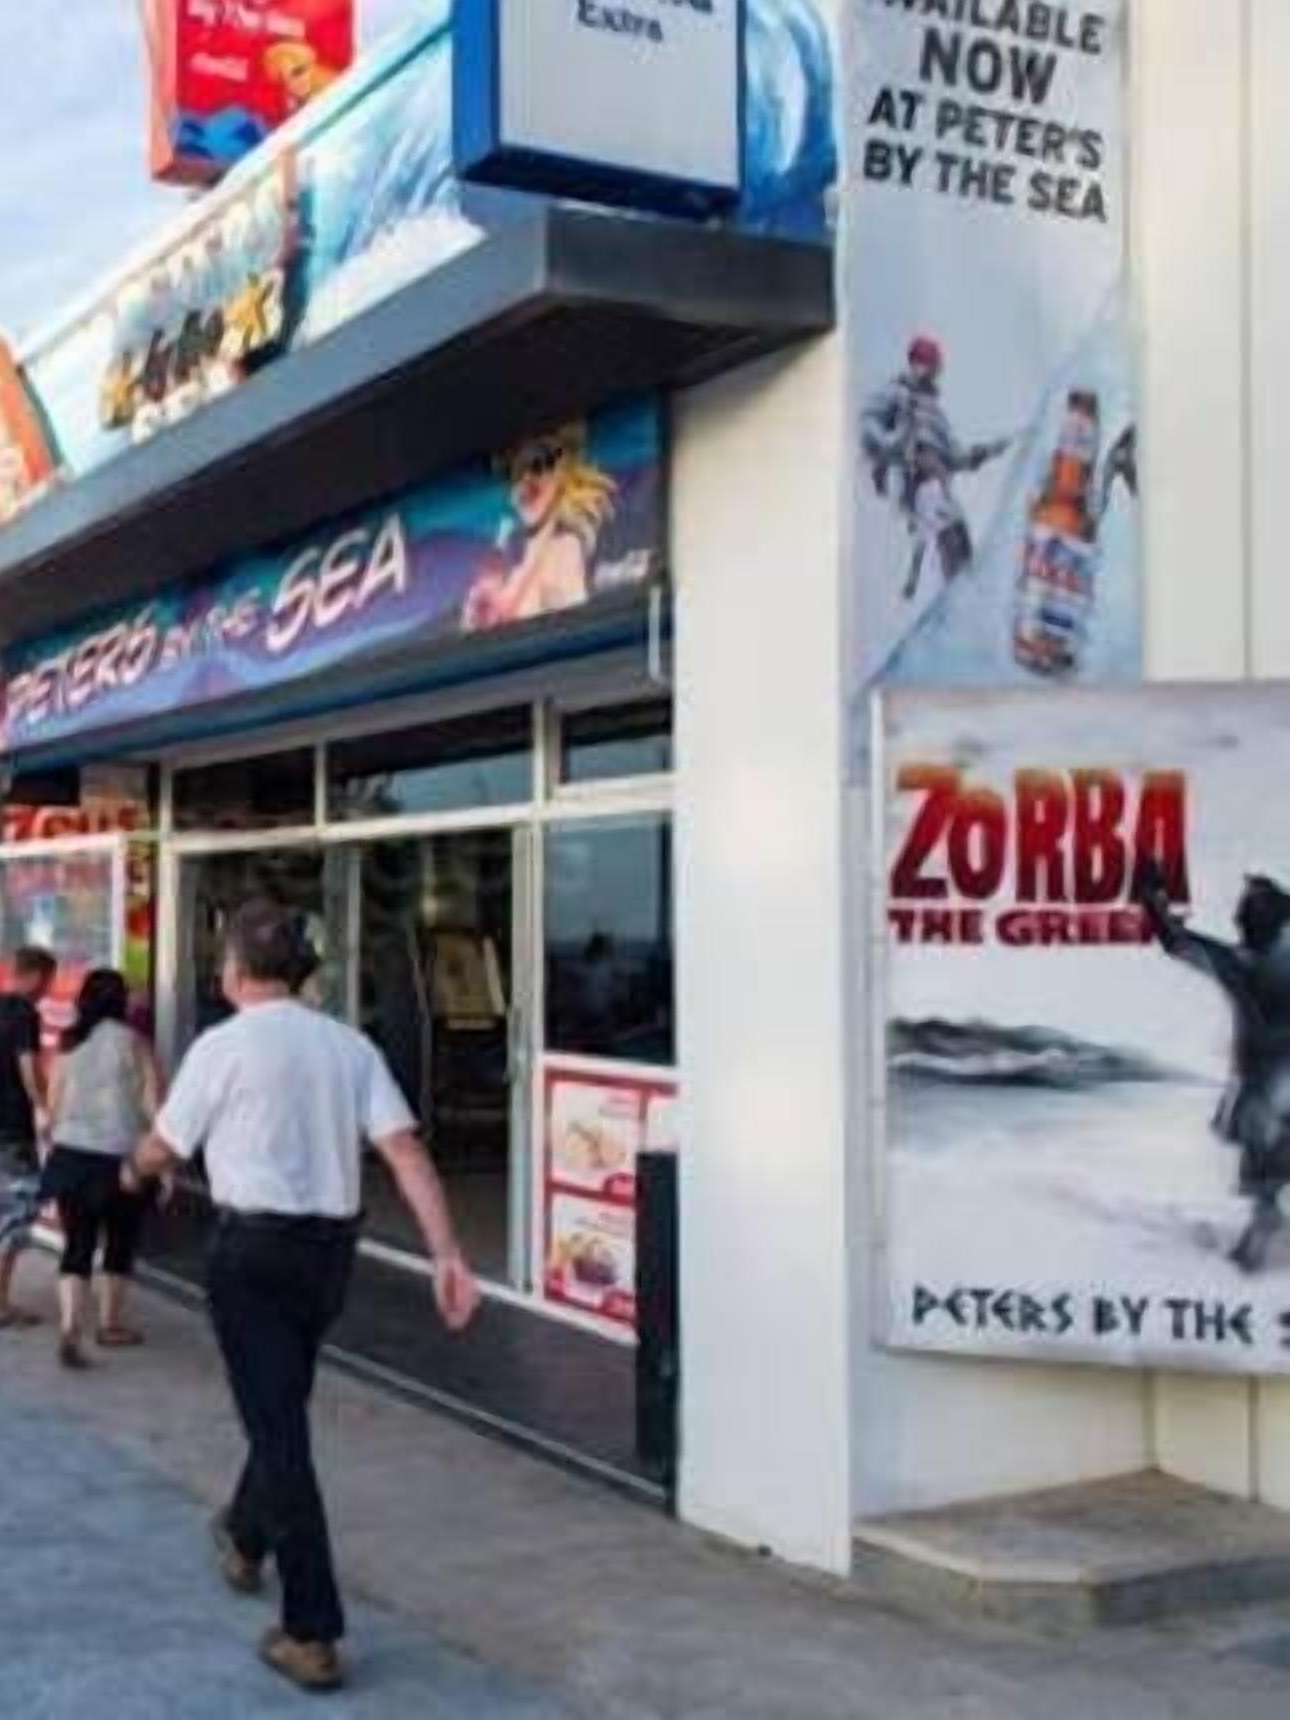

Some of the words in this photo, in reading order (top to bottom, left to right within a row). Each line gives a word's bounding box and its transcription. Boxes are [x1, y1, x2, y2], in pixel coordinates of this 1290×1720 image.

[885, 0, 1105, 54] AILABLE
[918, 26, 1057, 104] NOW
[867, 86, 924, 130] AT
[935, 98, 1103, 170] PETER'S
[863, 139, 923, 185] BY
[935, 151, 1017, 205] THE
[1027, 170, 1107, 223] SEA
[267, 512, 408, 652] SEA
[887, 908, 984, 945] THE
[912, 1285, 1074, 1335] PETERS
[1093, 1295, 1149, 1336] BY
[1163, 1298, 1253, 1346] THE
